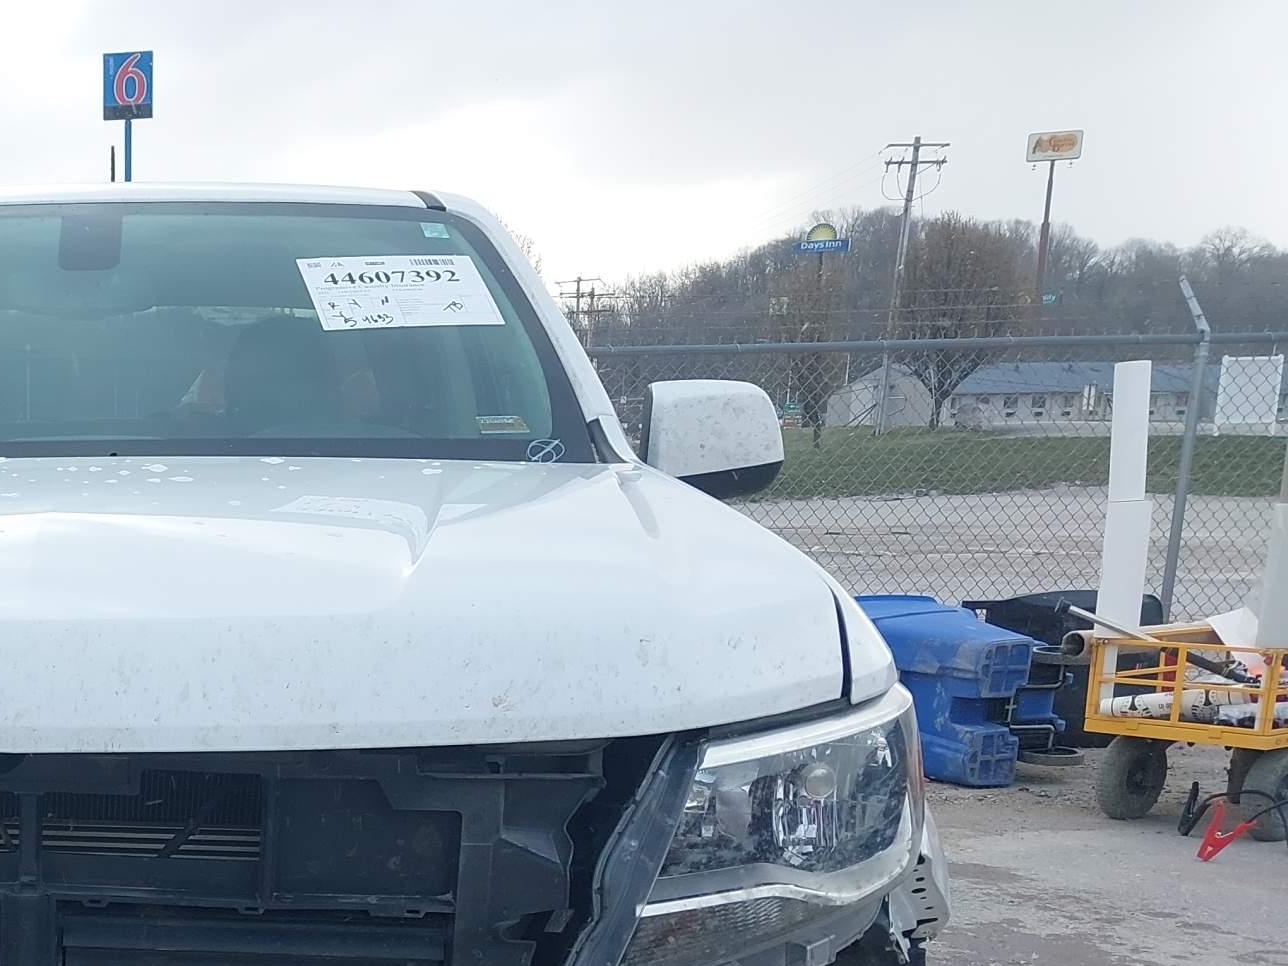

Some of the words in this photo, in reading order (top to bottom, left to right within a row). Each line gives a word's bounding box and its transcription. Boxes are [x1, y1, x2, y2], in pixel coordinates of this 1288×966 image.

[114, 53, 147, 105] 6
[800, 242, 824, 250] Days
[825, 240, 842, 248] Inn
[323, 269, 460, 286] 44607392
